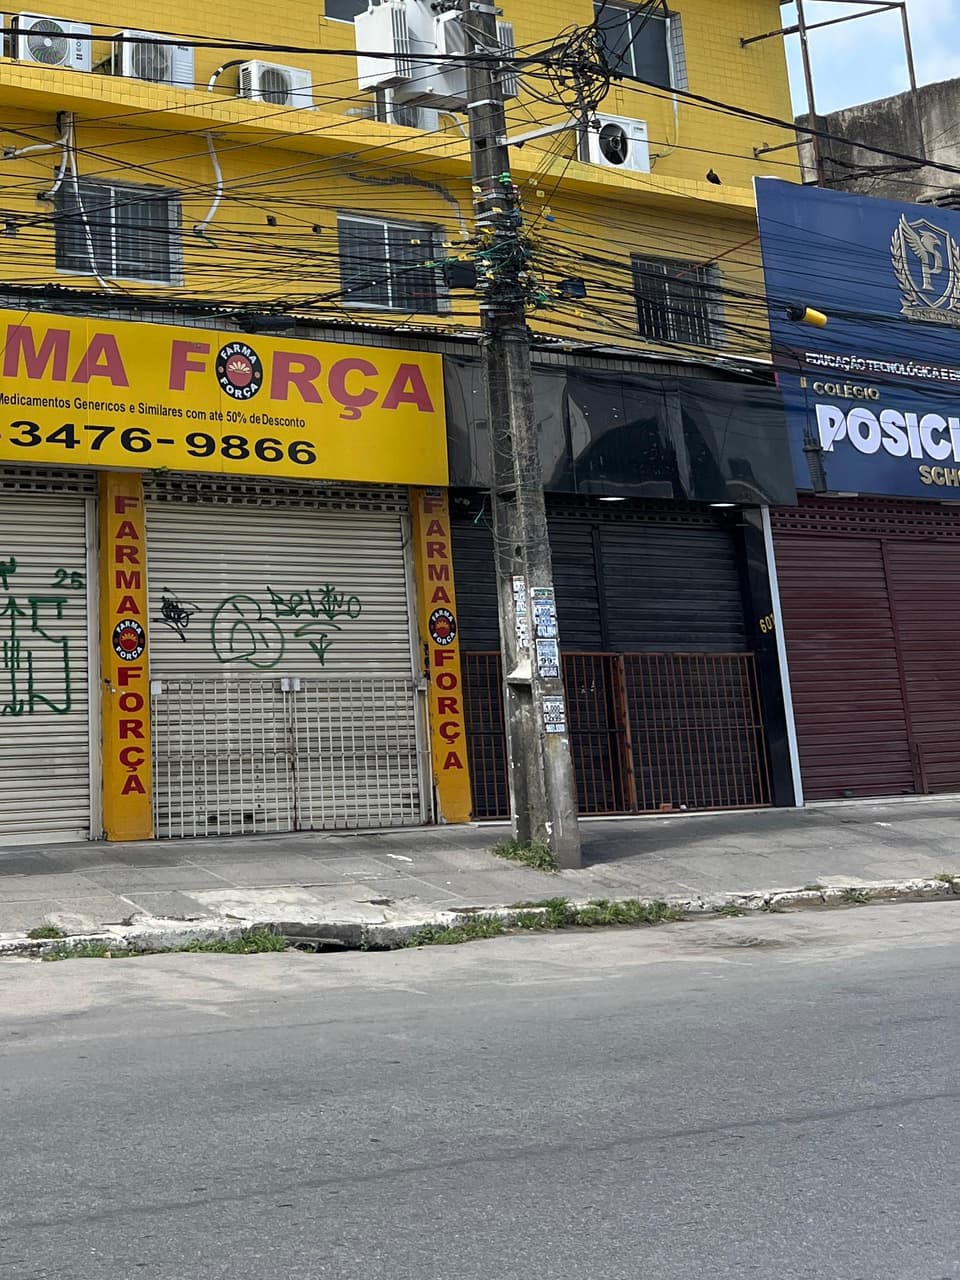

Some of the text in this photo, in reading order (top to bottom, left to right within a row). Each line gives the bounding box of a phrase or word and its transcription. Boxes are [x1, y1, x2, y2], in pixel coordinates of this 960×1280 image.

[220, 344, 257, 364] FARMA
[220, 377, 258, 398] FORÇA
[813, 380, 880, 401] COLÉGIO
[129, 404, 135, 413] e
[138, 402, 183, 418] Similares
[186, 409, 206, 420] com
[226, 410, 247, 424] 50%
[262, 414, 305, 428] Desconto
[8, 420, 317, 465] 3476-9866
[919, 465, 960, 487] SCH
[115, 495, 140, 615] FARMA
[423, 496, 451, 604] FARMA
[116, 621, 142, 634] FARMA
[759, 613, 775, 633] 60
[435, 648, 463, 771] FORÇA
[117, 666, 146, 795] FORÇA
